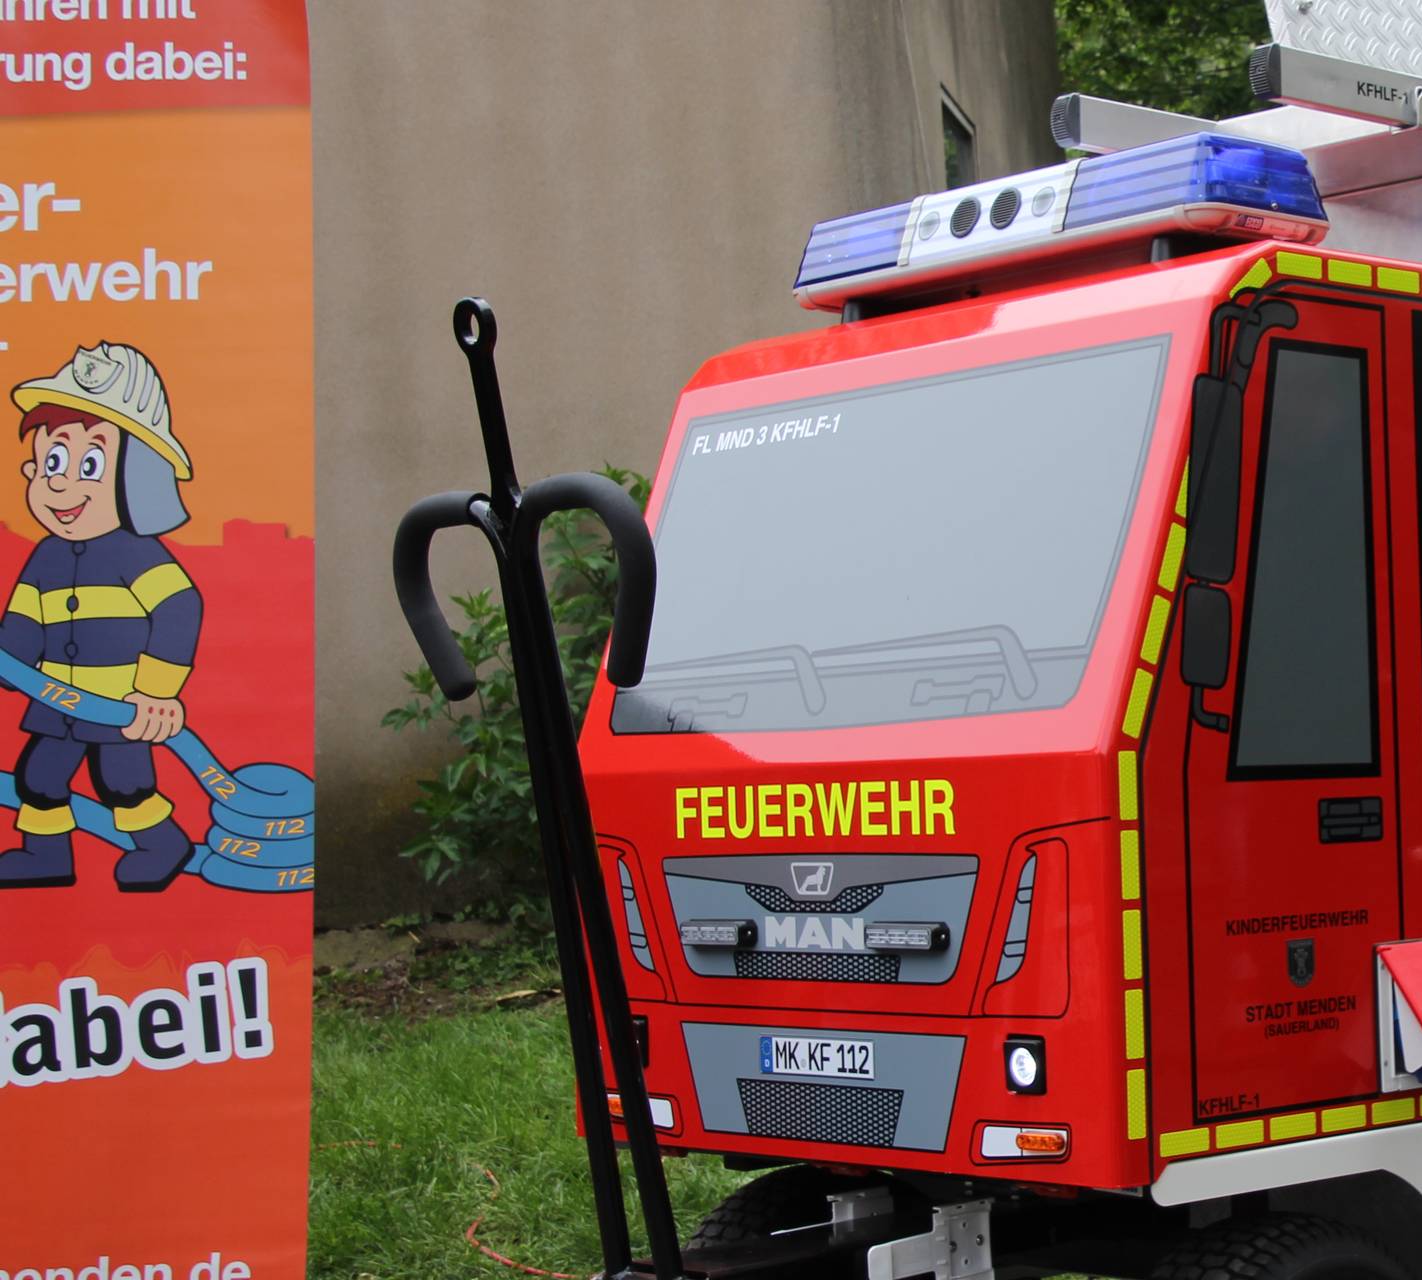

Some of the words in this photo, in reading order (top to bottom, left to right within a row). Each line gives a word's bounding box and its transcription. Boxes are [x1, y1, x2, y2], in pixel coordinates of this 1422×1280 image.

[0, 0, 108, 21] hren
[122, 0, 197, 19] mit
[105, 41, 248, 80] dabei:
[1356, 80, 1409, 104] KFHLF-1
[692, 435, 712, 456] FL
[715, 427, 755, 453] MND
[756, 425, 768, 446] 3
[770, 413, 842, 443] KFHLF-1
[39, 682, 81, 710] 112
[200, 766, 237, 800] 112
[675, 779, 956, 840] FEUERWEHR
[264, 818, 305, 836] 112
[218, 837, 261, 858] 112
[277, 870, 314, 887] 112
[764, 915, 865, 951] MAN
[1226, 909, 1369, 936] KINDERFEUERWEHR
[1245, 1002, 1293, 1023] STADT
[1297, 995, 1357, 1017] MENDEN
[1264, 1018, 1340, 1039] (SAUERLAND)
[775, 1041, 800, 1071] MK
[808, 1042, 831, 1072] KF
[836, 1044, 870, 1075] 112
[1199, 1092, 1260, 1115] KFHLF-1
